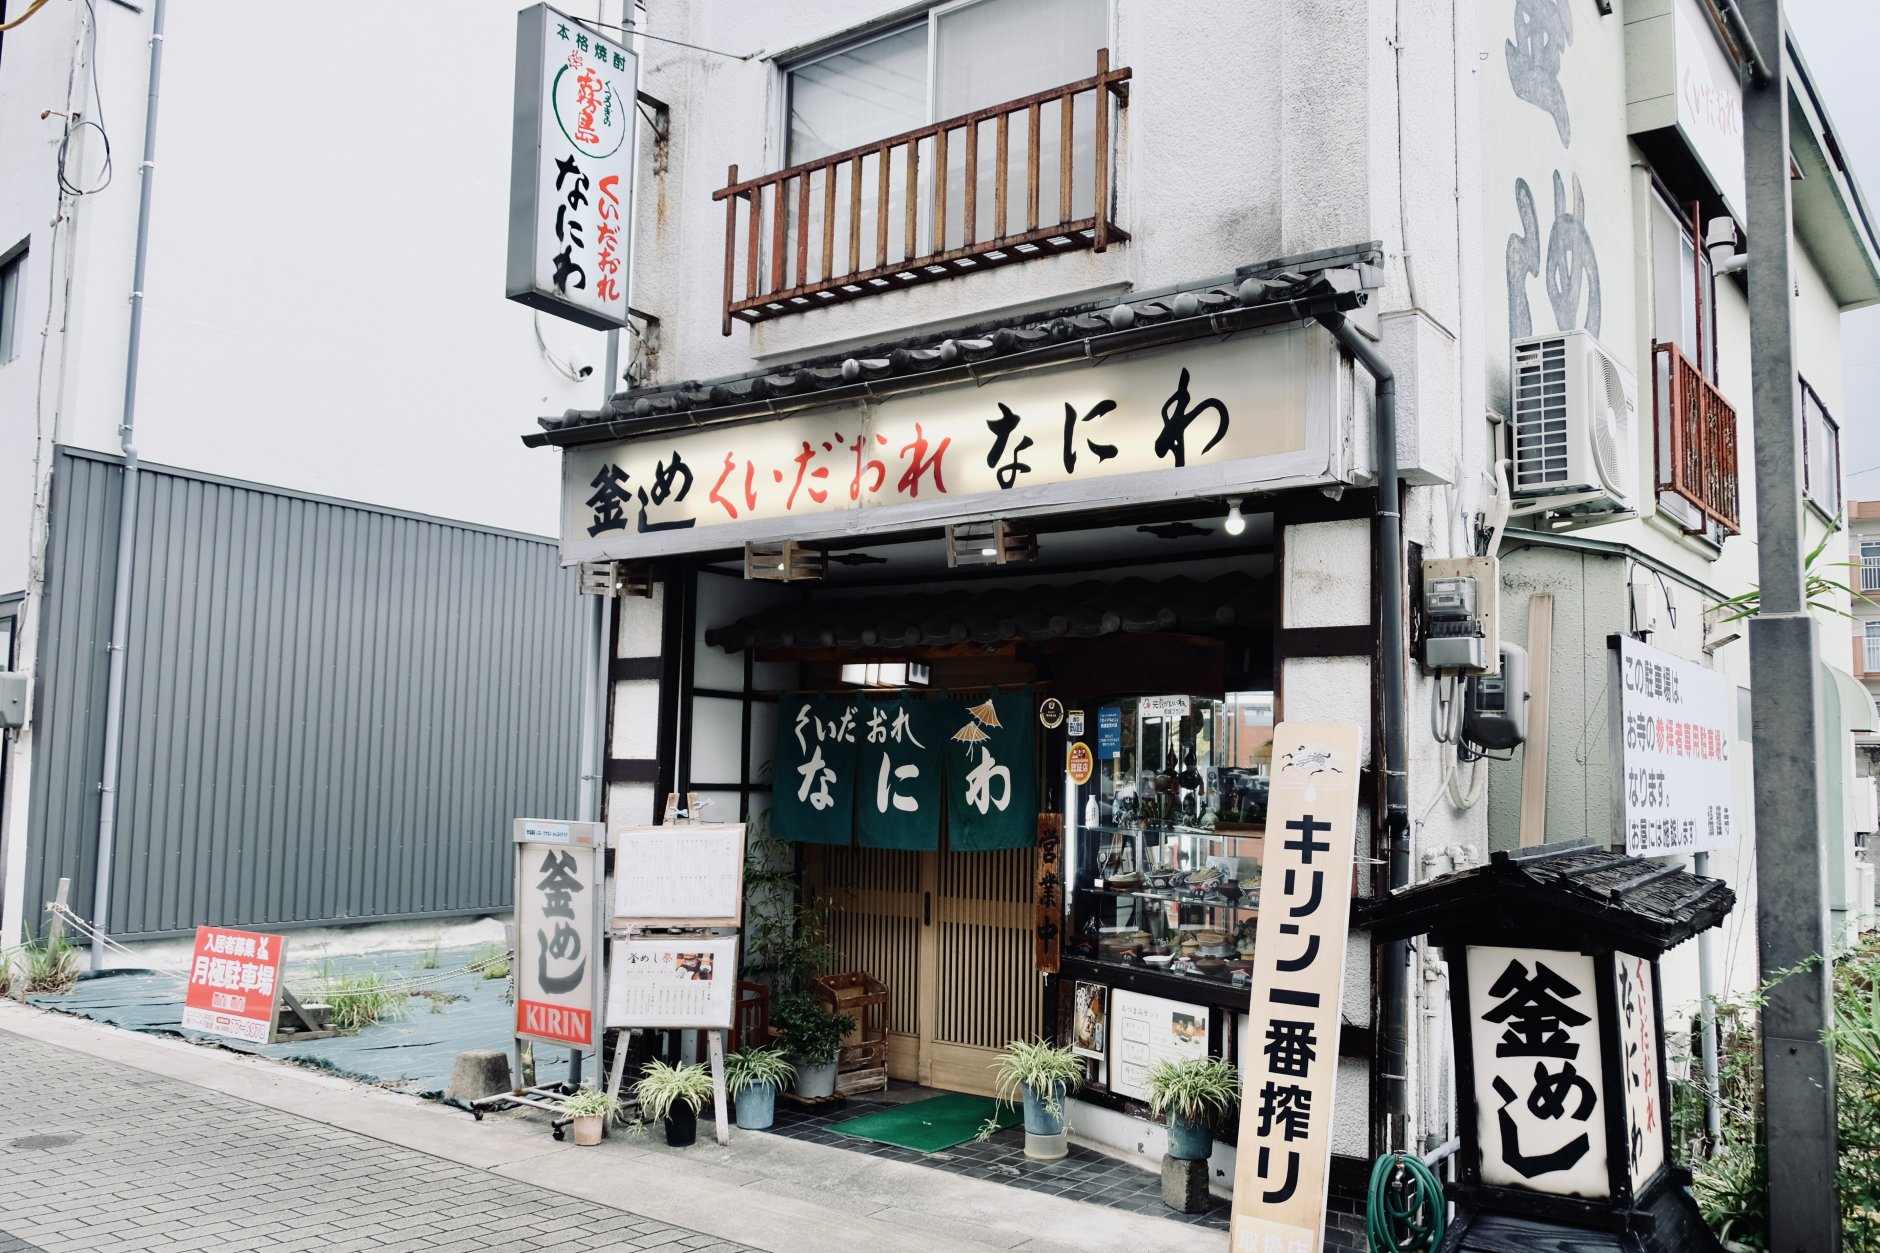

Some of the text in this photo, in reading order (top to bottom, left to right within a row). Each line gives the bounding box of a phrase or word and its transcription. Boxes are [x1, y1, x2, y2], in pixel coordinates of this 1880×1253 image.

[556, 22, 626, 72] 本格焼酎
[553, 154, 589, 294] なにわ
[597, 175, 620, 303] くいだおれ
[585, 366, 1230, 538] 釜めし くいだおれ なにわ
[795, 703, 926, 756] くいだおれ
[1625, 656, 1684, 705] この駐車場は、
[797, 745, 1012, 815] なにわ
[1628, 766, 1670, 808] なります。
[204, 933, 257, 958] 入居者募集
[536, 849, 587, 995] 釜めし
[1037, 828, 1060, 954] 営業中
[192, 956, 275, 996] 月極駐車場
[525, 1004, 586, 1040] KIRIN
[1256, 814, 1332, 1204] キリン一番搾り
[1481, 958, 1598, 1179] 釜めし
[1619, 960, 1643, 1176] なにわ
[1636, 957, 1656, 1134] くいだおれ
